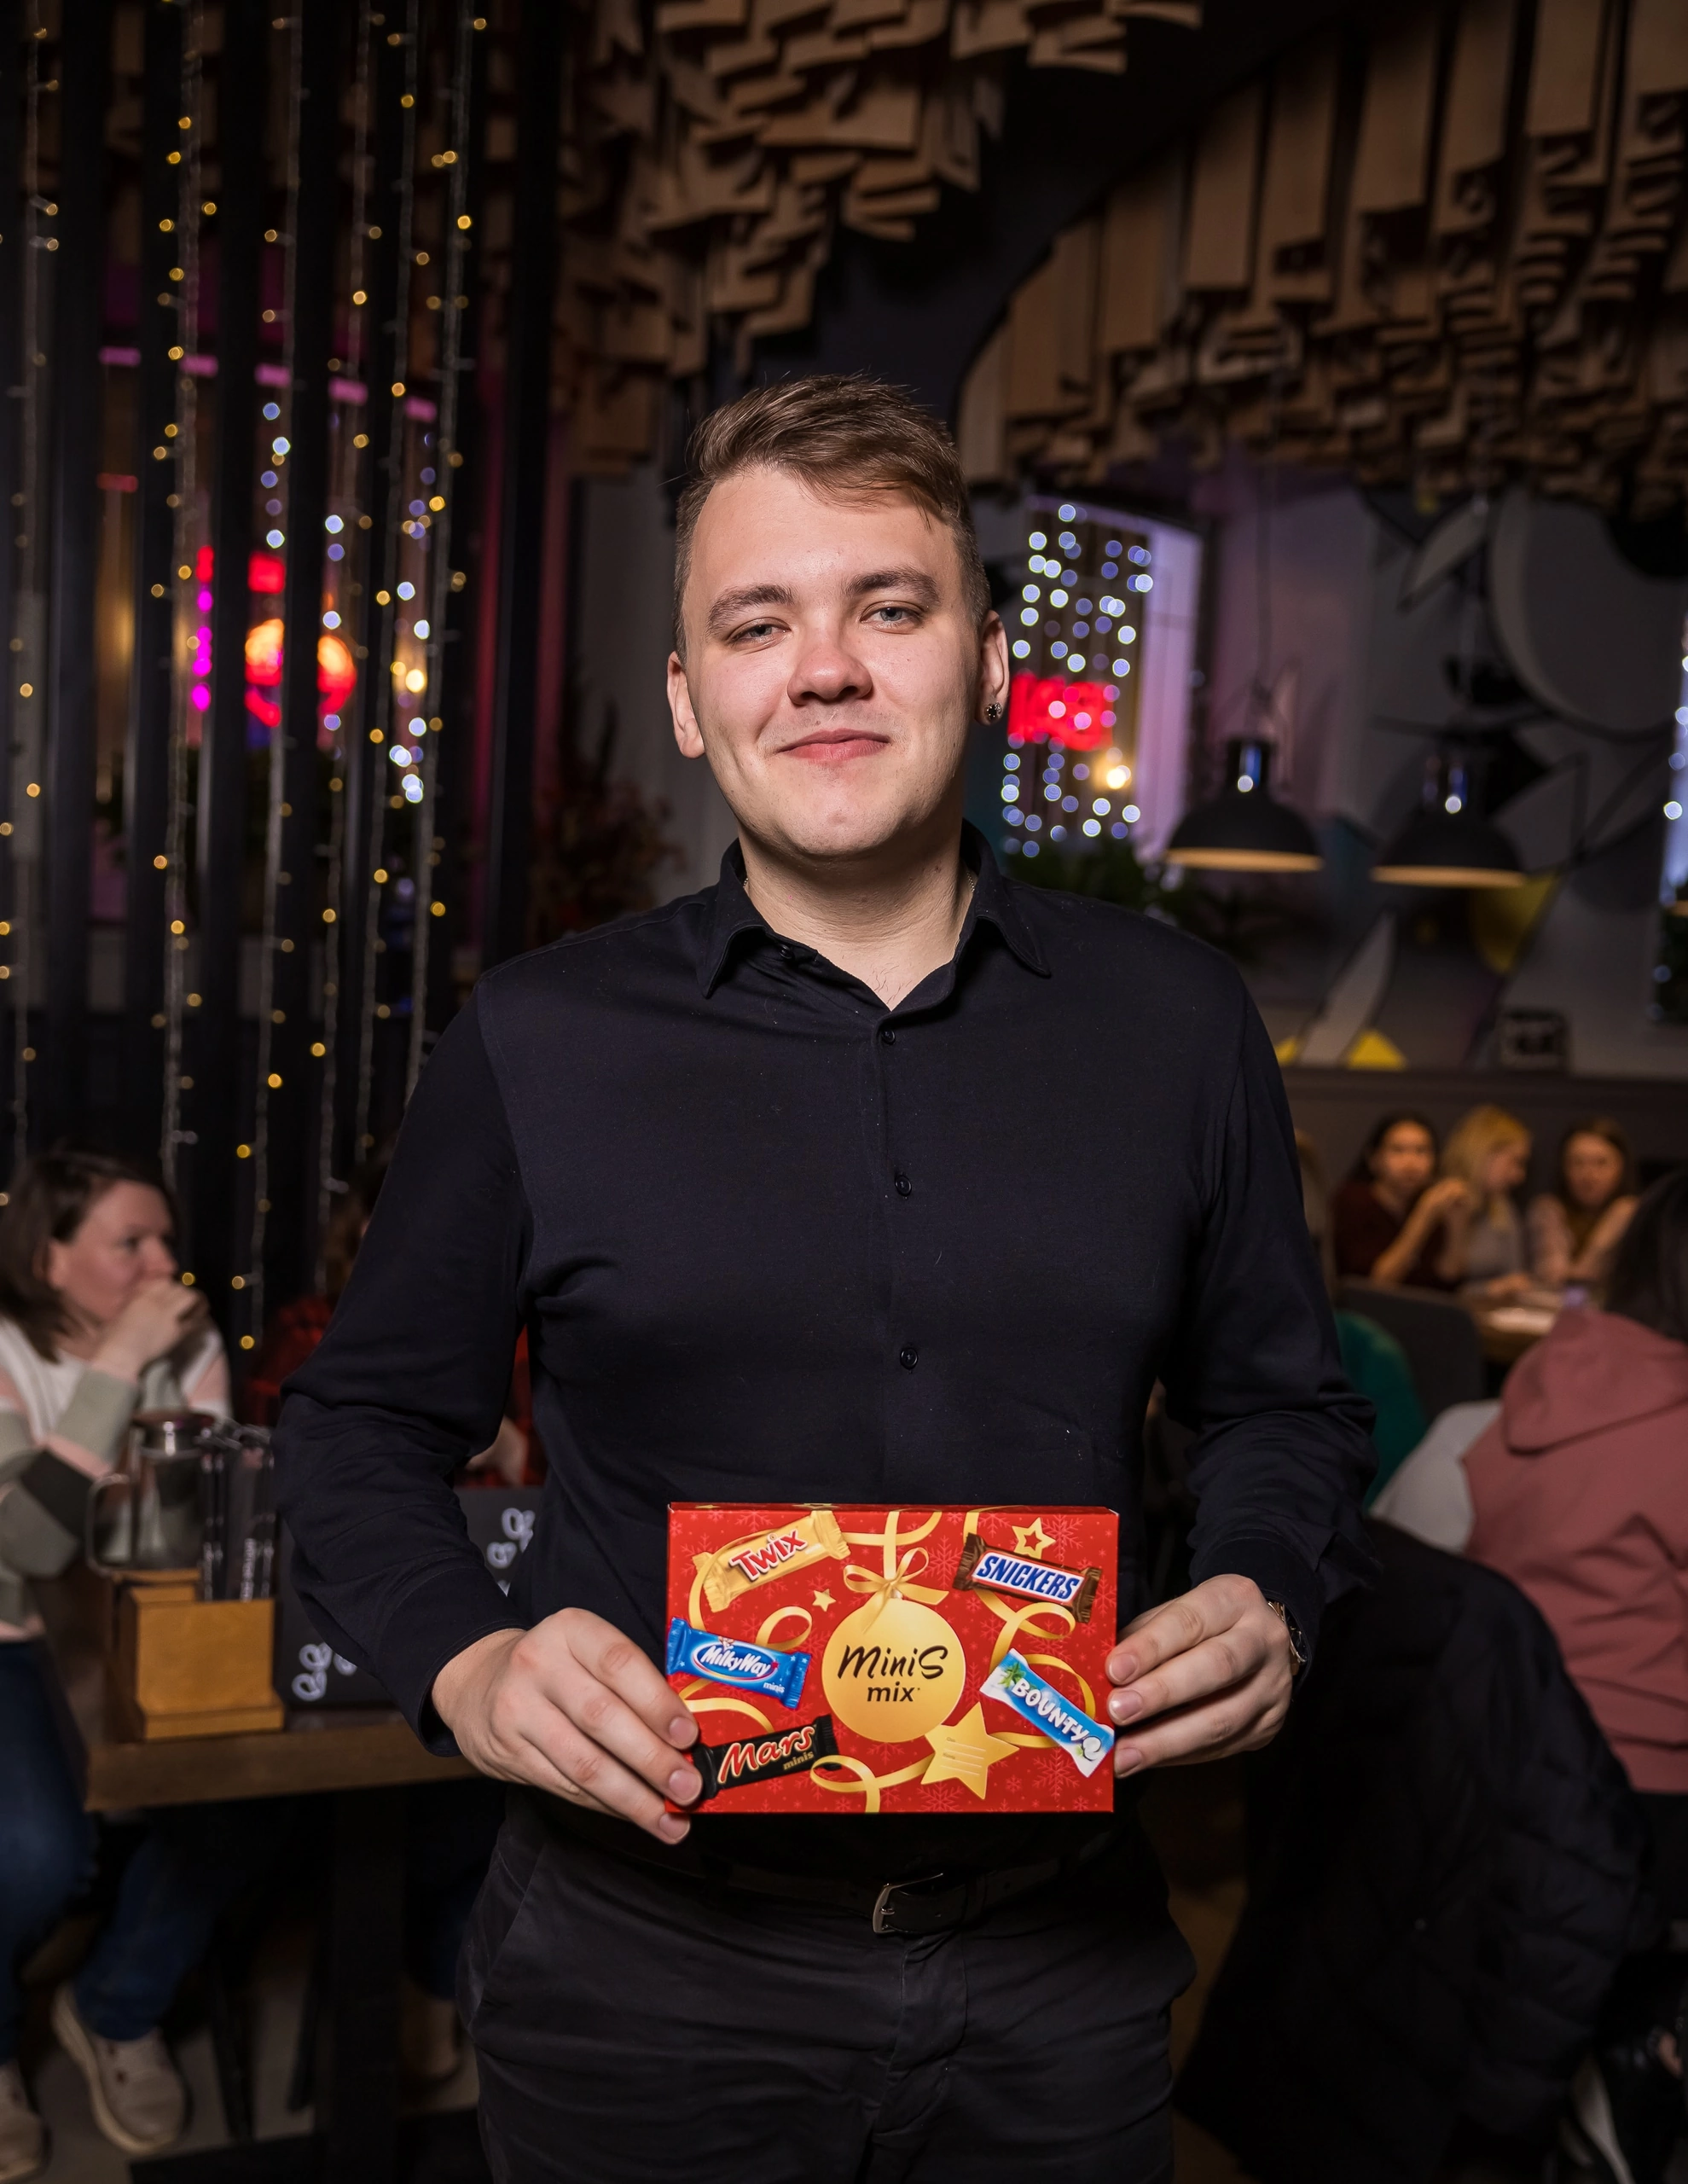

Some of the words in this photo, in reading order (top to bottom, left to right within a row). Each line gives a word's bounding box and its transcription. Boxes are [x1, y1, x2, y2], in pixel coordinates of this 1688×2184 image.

[729, 1530, 807, 1581] Twix
[977, 1555, 1080, 1600] SNICKERS
[867, 1681, 915, 1702] mix
[1012, 1678, 1089, 1741] BOUNTY
[717, 1726, 815, 1784] Mars
[783, 1751, 814, 1770] minis
